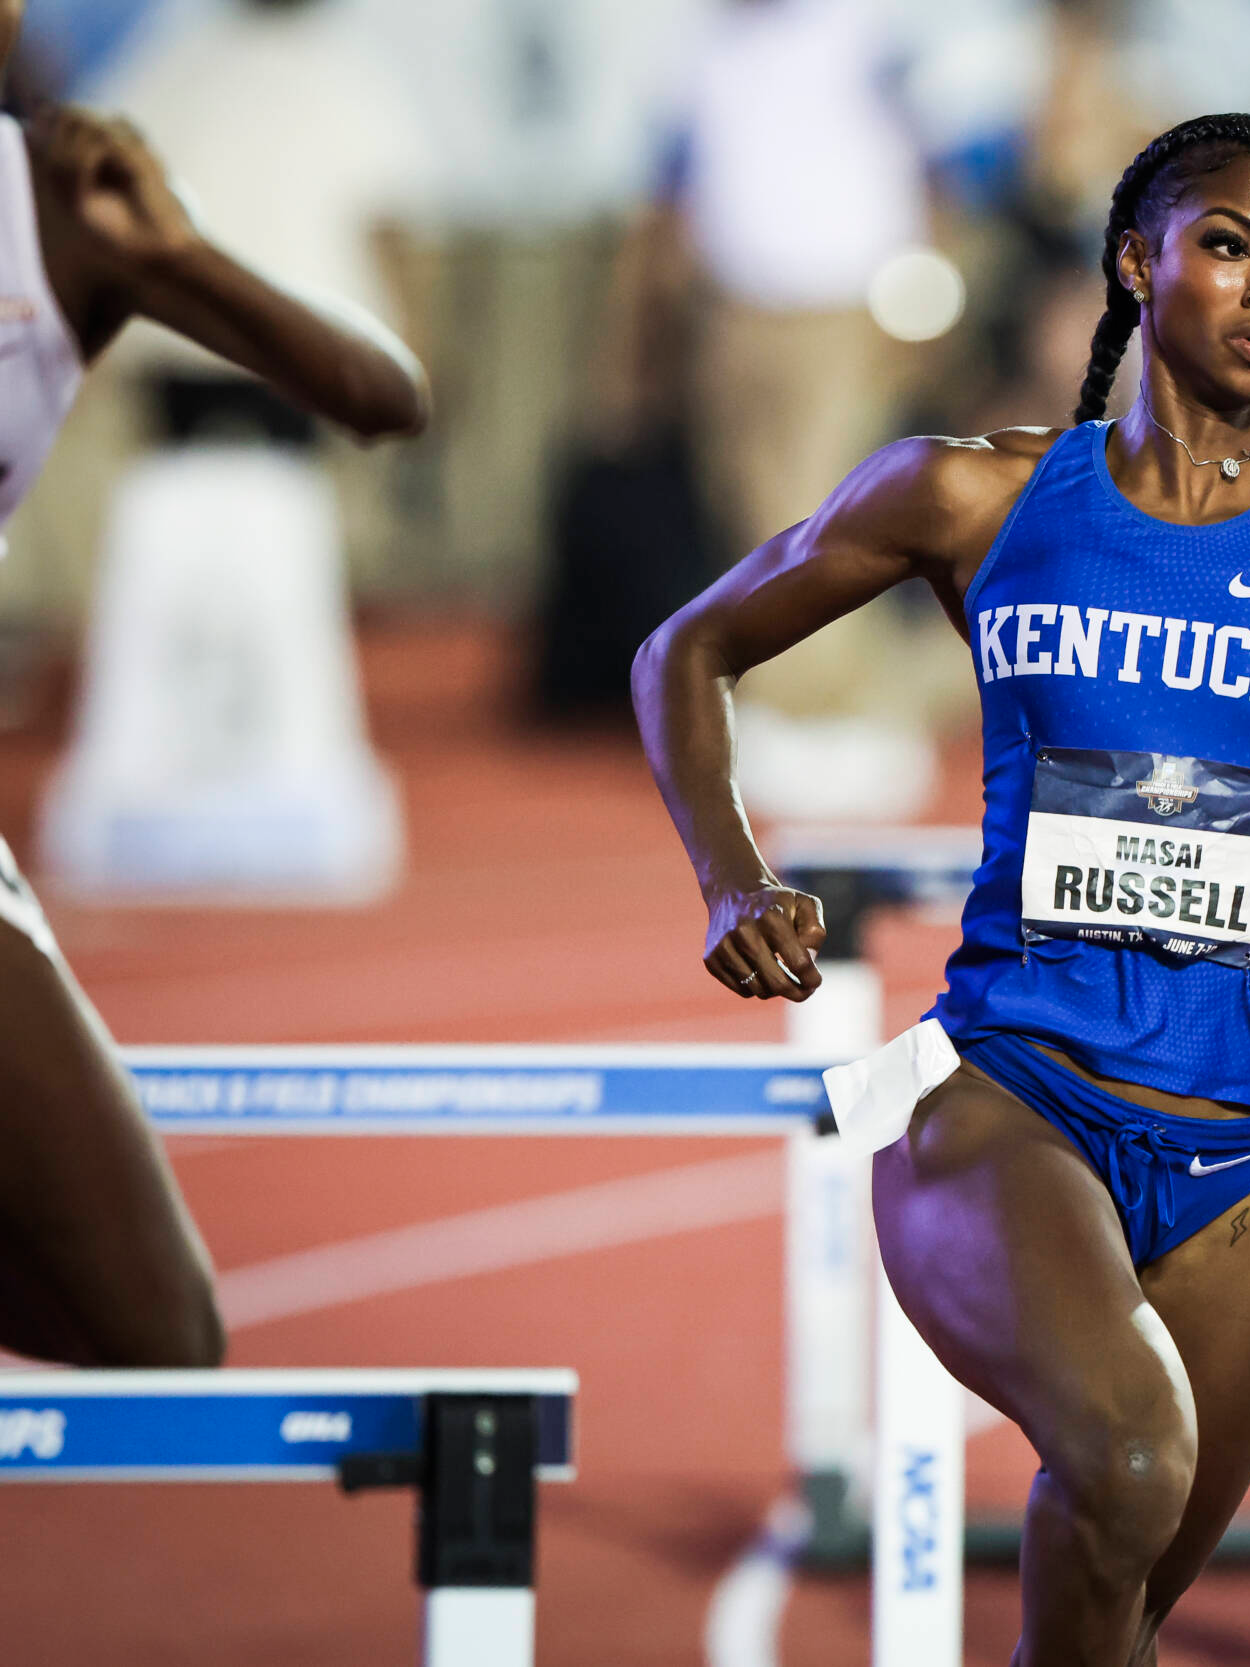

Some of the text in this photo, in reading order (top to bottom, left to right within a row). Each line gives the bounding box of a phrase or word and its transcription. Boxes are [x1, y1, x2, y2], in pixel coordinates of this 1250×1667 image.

[1115, 835, 1203, 869] MASAI
[1053, 865, 1248, 932] RUSSELL
[1129, 931, 1143, 943] TX
[1162, 938, 1196, 955] JUNE
[903, 1451, 936, 1592] NCAA
